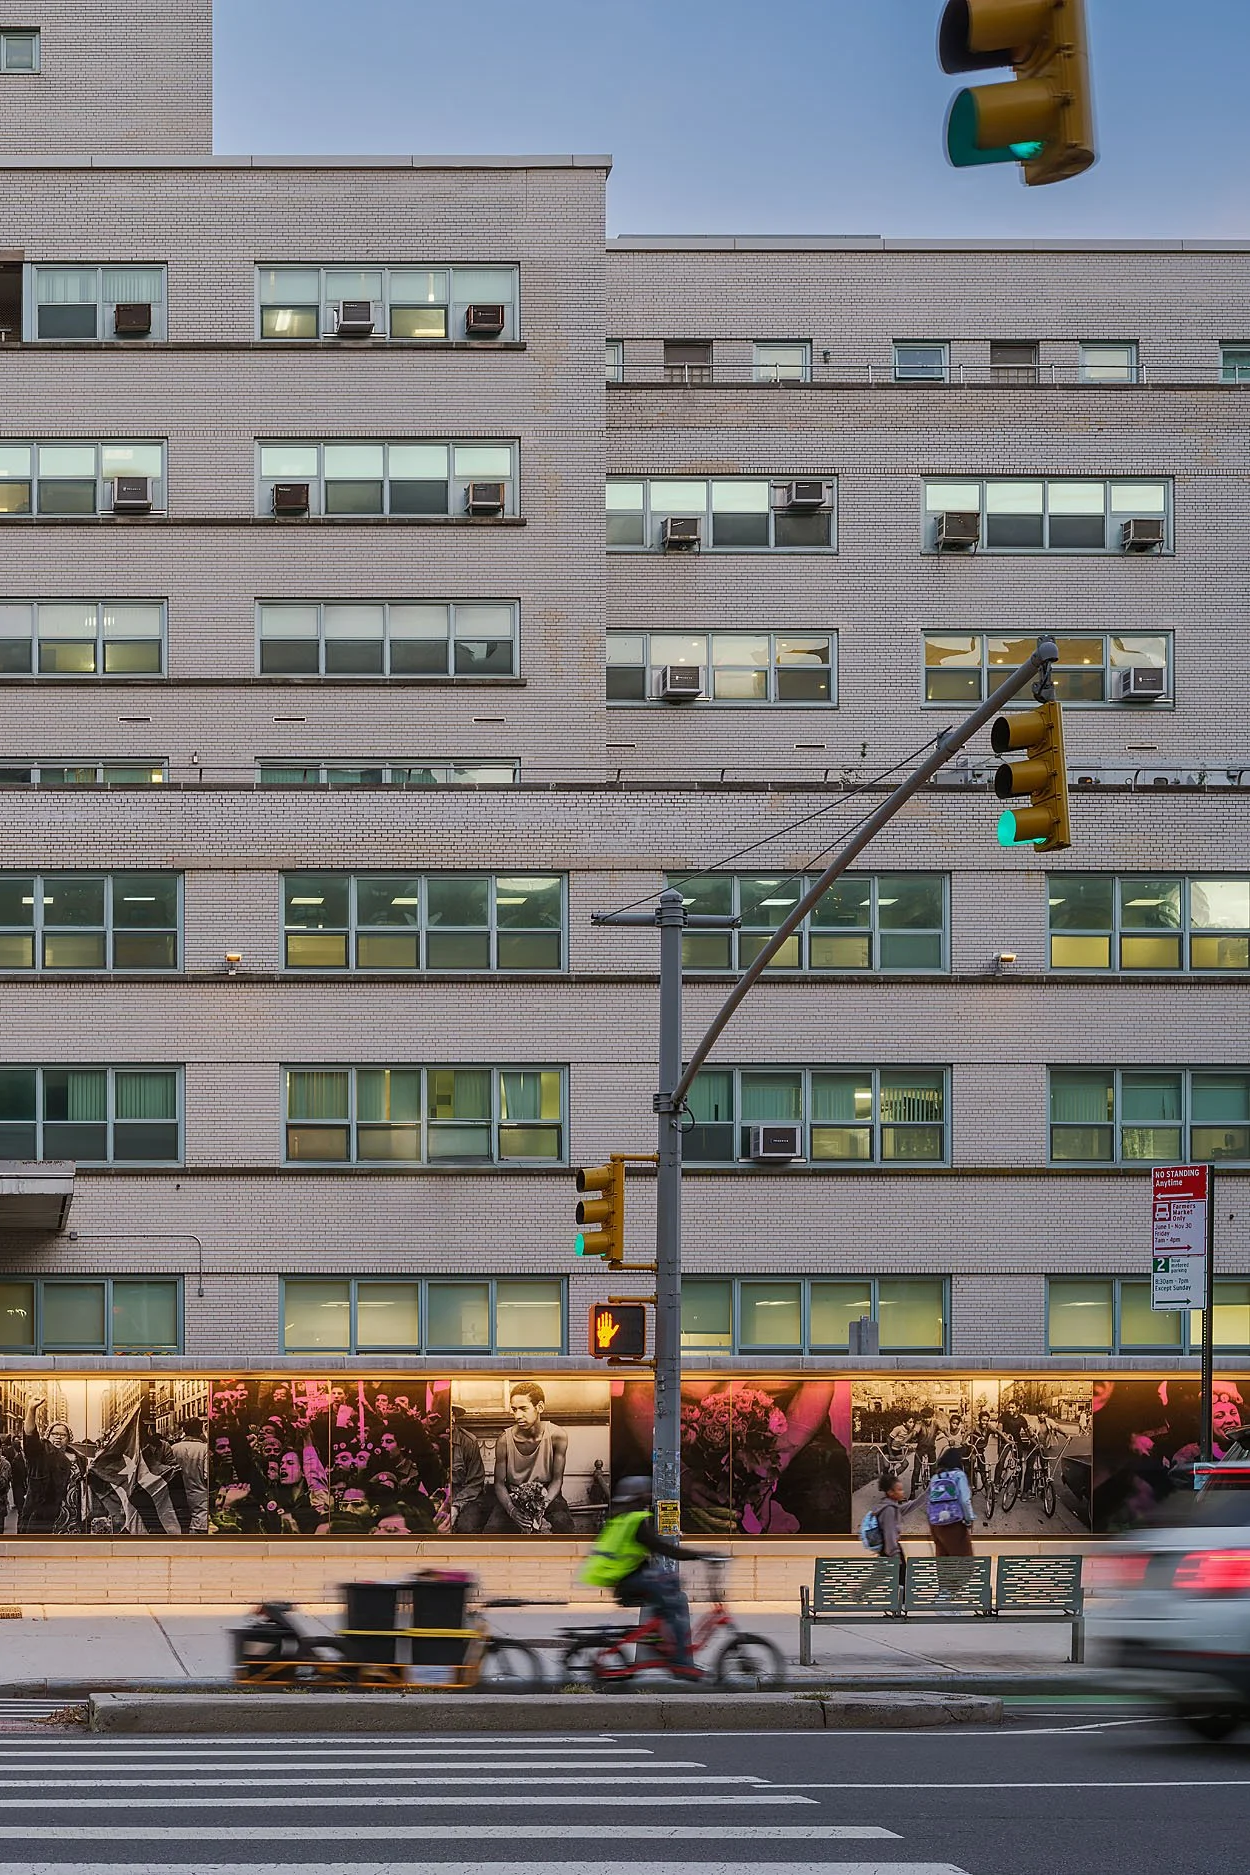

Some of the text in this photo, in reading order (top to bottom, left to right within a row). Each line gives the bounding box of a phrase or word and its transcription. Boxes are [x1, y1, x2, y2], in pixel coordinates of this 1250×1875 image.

[1167, 1169, 1199, 1177] STANDING
[1156, 1179, 1182, 1188] Anytime
[1157, 1258, 1165, 1271] 2
